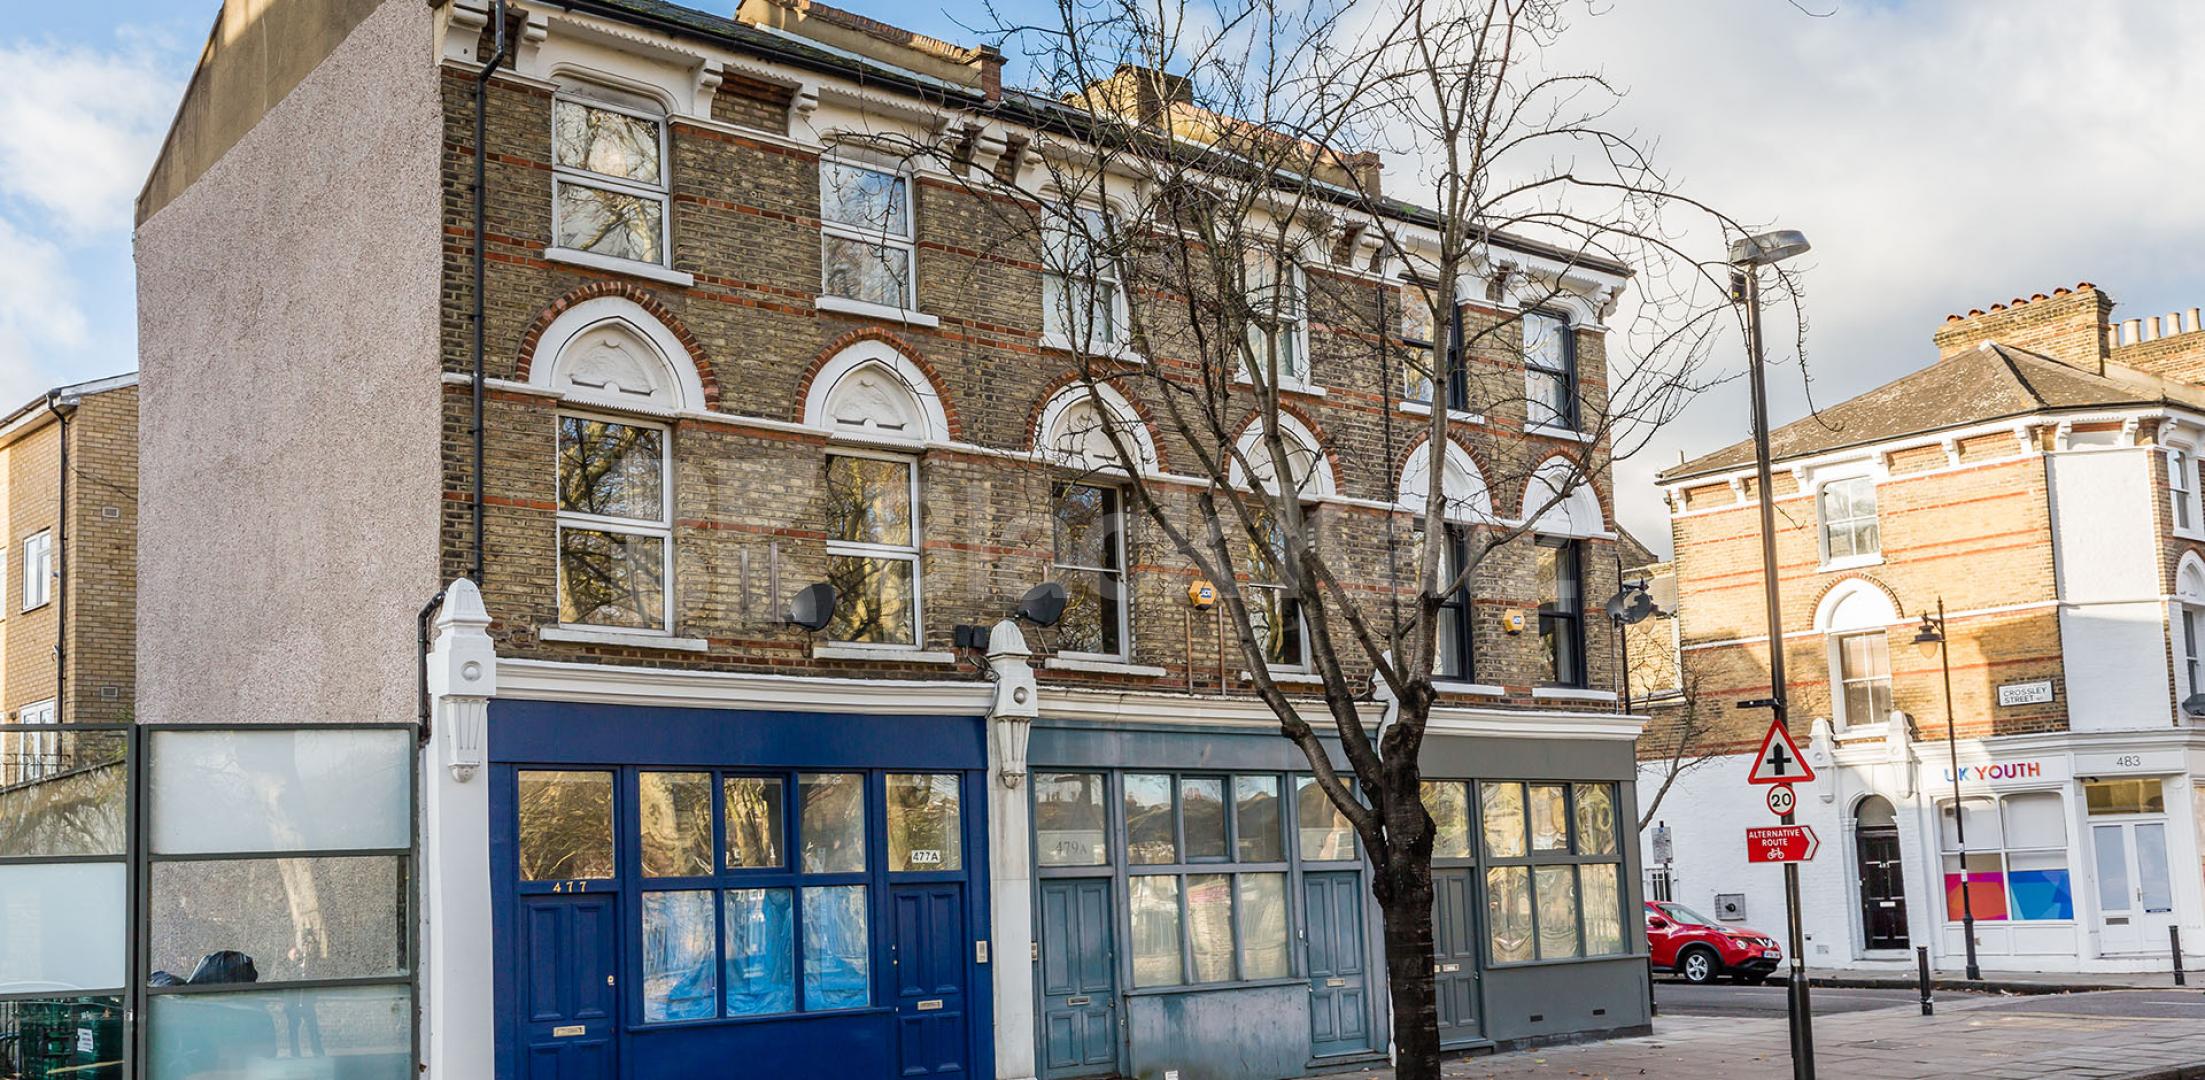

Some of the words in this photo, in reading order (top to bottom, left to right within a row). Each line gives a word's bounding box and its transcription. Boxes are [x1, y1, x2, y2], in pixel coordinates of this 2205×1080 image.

[2003, 686, 2047, 697] CROSSLEY
[2004, 695, 2034, 704] STREET
[2116, 755, 2141, 767] 483
[1974, 761, 2041, 780] YOUTH
[1771, 793, 1791, 807] 20
[1749, 829, 1800, 839] ALTERNATIVE
[1761, 838, 1788, 847] ROUTE
[913, 852, 938, 861] 477A
